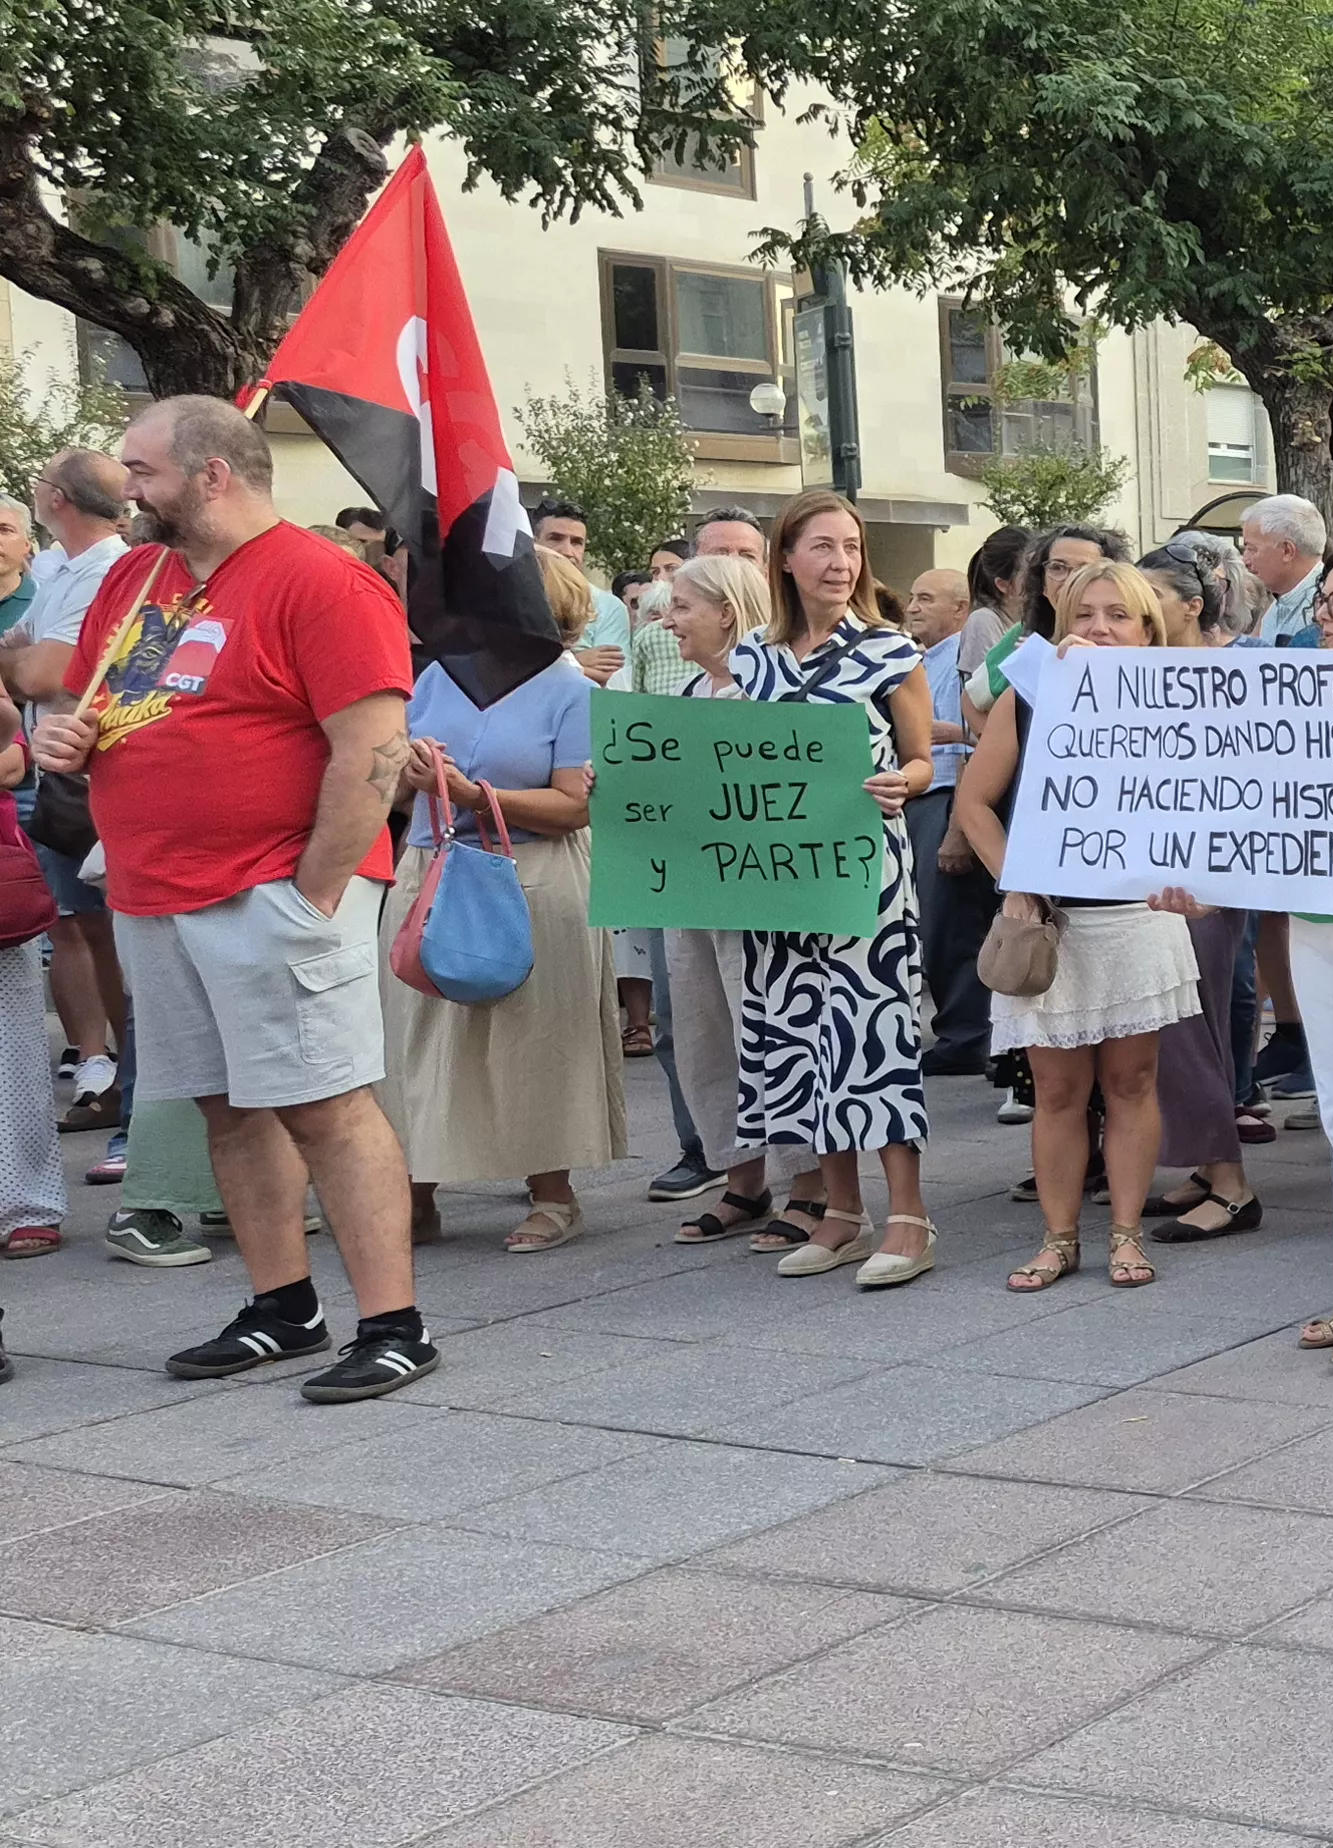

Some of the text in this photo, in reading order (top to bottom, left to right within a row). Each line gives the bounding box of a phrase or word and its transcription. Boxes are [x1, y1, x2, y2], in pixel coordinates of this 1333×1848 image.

[165, 672, 204, 692] CGT
[1071, 661, 1099, 713] A
[1118, 663, 1248, 710] NUESTRO
[603, 719, 823, 773] ¿Se puede
[1047, 722, 1197, 761] QUEREMOS
[1205, 719, 1296, 759] DANDO
[625, 782, 808, 823] ser JUEZ
[1041, 775, 1099, 812] NO
[1117, 775, 1263, 813] HACIENDO
[650, 835, 876, 894] y PARTE?
[1058, 827, 1127, 870] POR
[1149, 831, 1197, 869] UN
